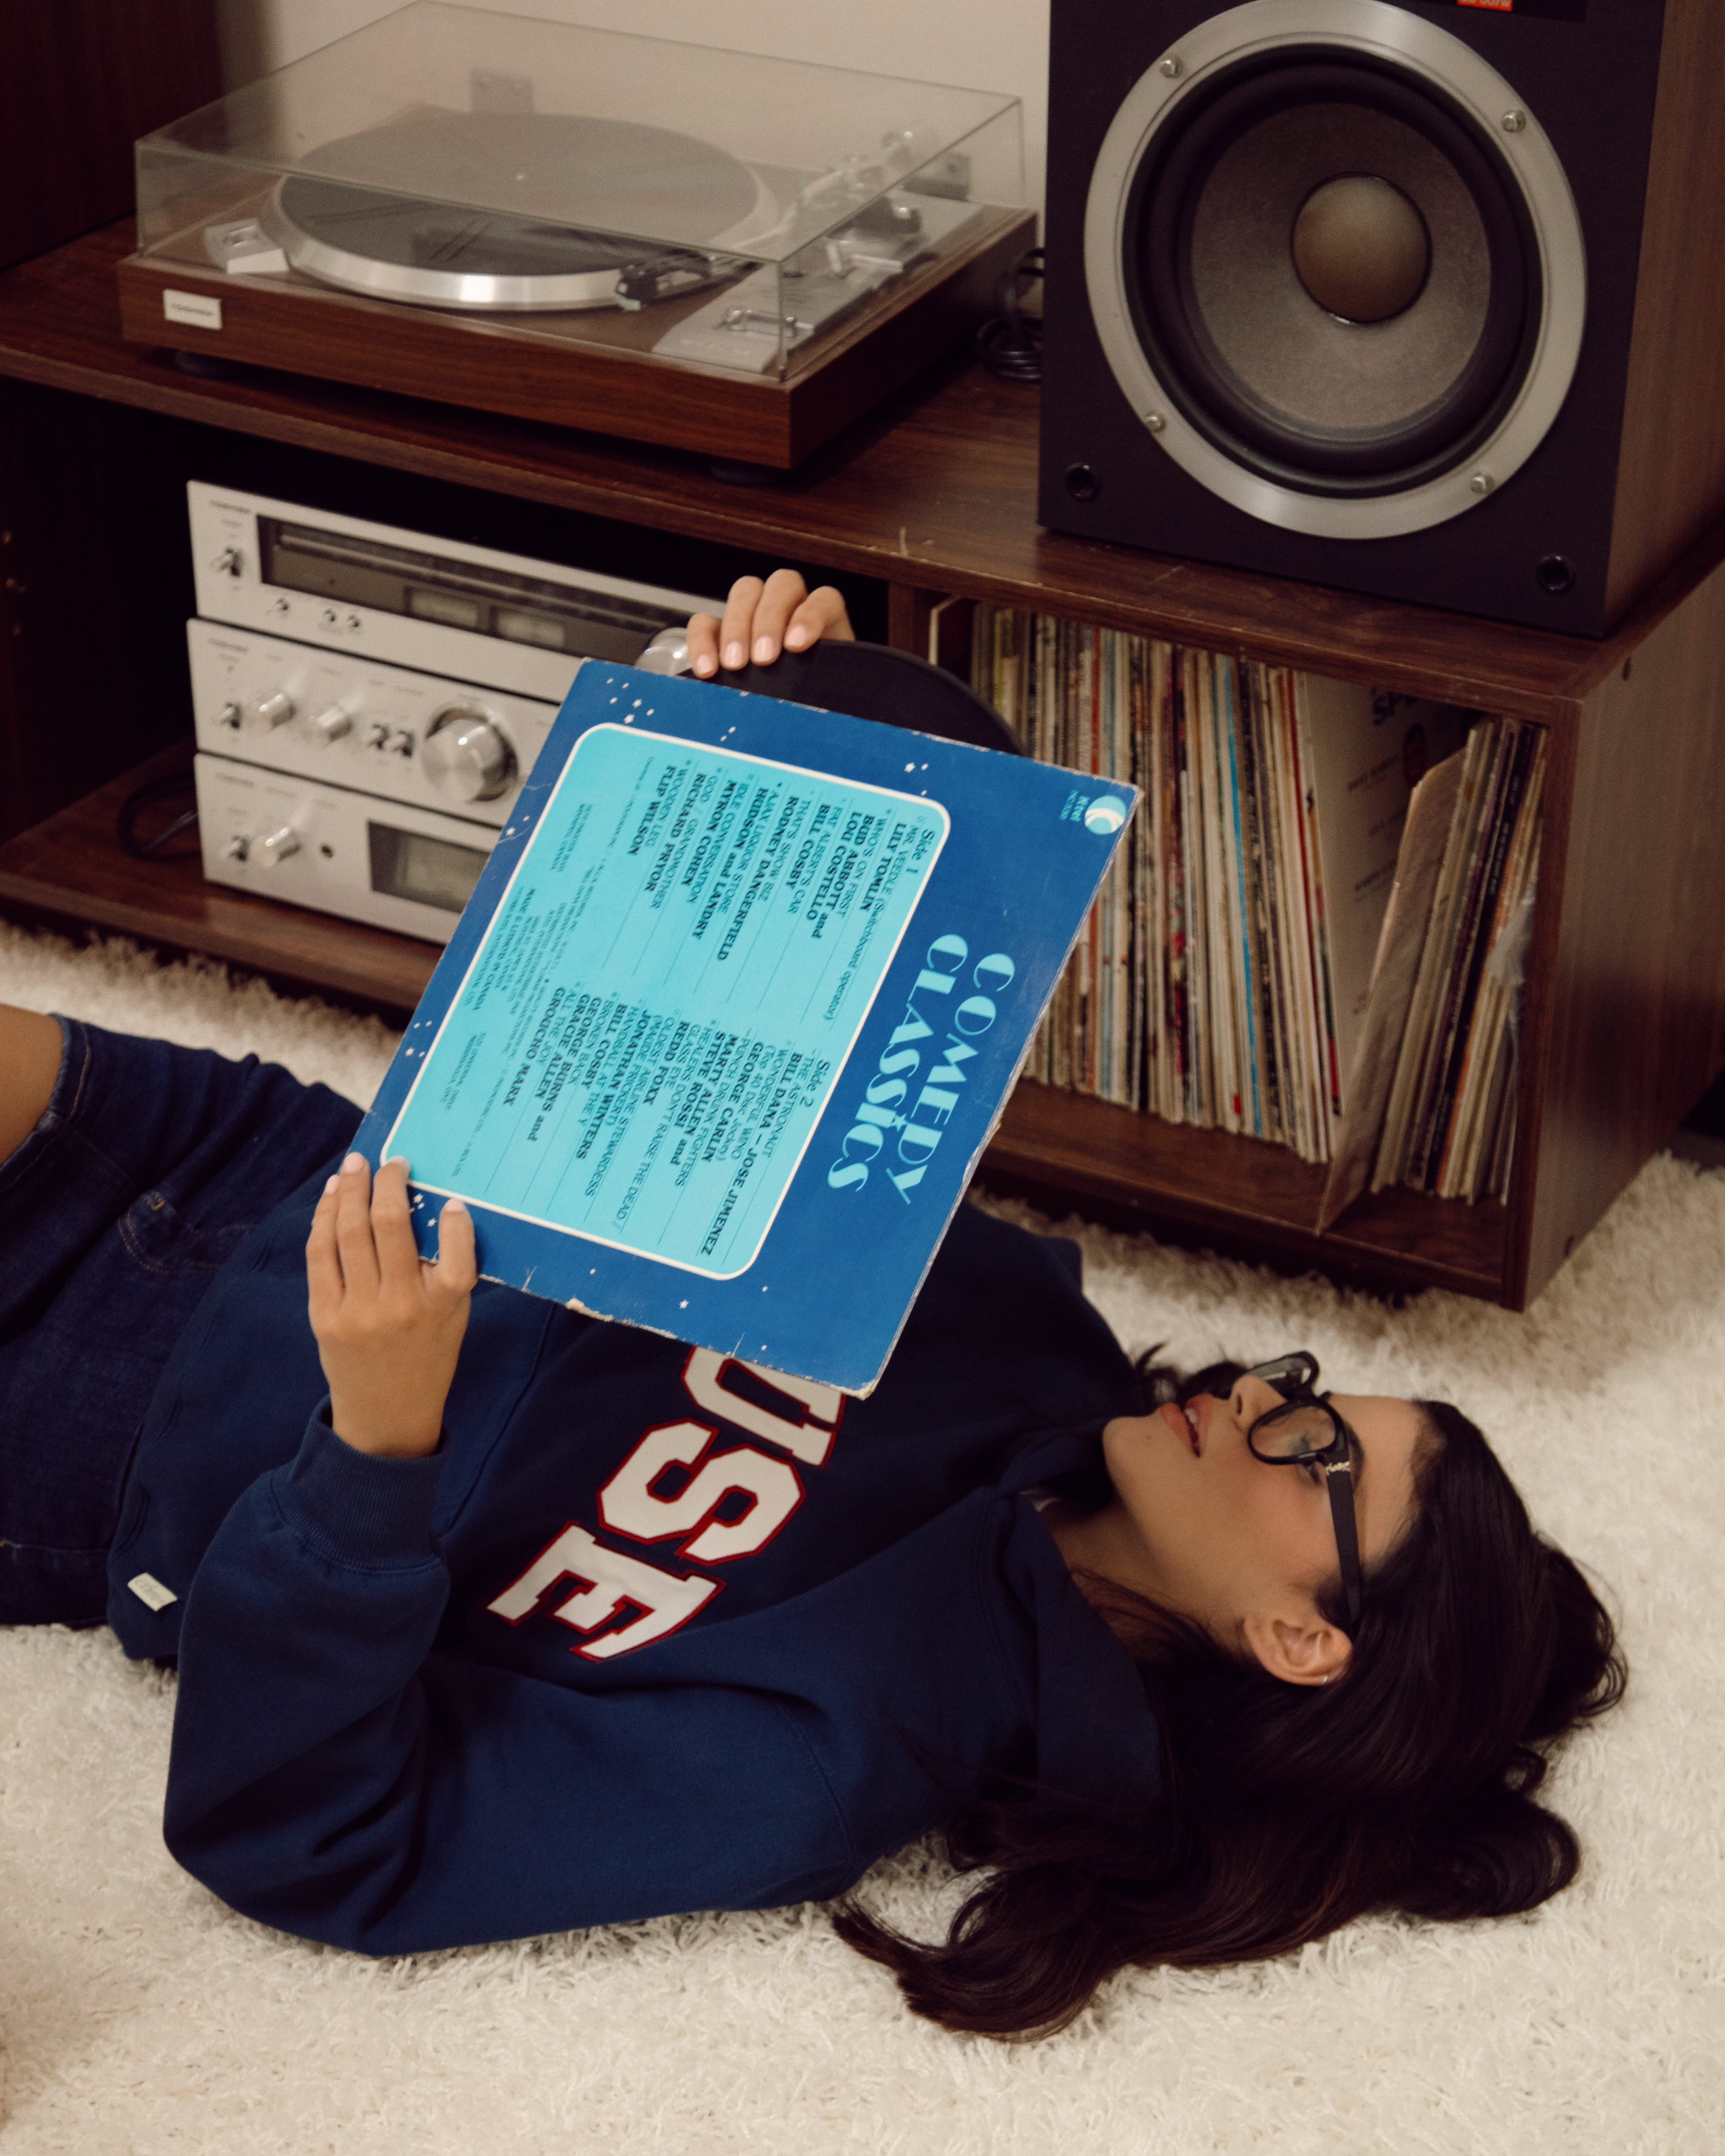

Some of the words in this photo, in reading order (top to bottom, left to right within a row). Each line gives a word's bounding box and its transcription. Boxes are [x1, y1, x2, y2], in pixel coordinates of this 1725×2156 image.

[656, 765, 676, 797] FLIP
[658, 768, 688, 820] WOODEN
[700, 775, 717, 802] GOD
[730, 782, 749, 809] IDLE
[670, 773, 706, 838] RICHARD
[706, 779, 737, 831] MYRON
[733, 787, 768, 849] HUDSON
[758, 792, 779, 821] AJAX
[808, 804, 830, 834] BILL
[826, 806, 843, 828] FAT
[627, 801, 661, 855] WILSON
[644, 824, 662, 847] LEG
[765, 796, 799, 856] RODNEY
[840, 812, 862, 841] LOU
[854, 814, 875, 845] BUD
[886, 822, 907, 853] LILY
[911, 828, 934, 860] Side
[644, 843, 675, 891] PRYOR
[680, 835, 711, 886] COHEN
[687, 812, 735, 903] CONVERSATION
[719, 851, 736, 878] and
[736, 824, 765, 870] LIQUOR
[768, 842, 791, 877] SHOW
[785, 839, 814, 889] COSBY
[806, 845, 847, 920] COSTELLO
[825, 849, 858, 910] ABBOTT
[854, 860, 866, 879] ON
[859, 857, 892, 910] TOMLIN
[691, 881, 726, 939] LANDRY
[716, 872, 742, 914] STORE
[717, 859, 771, 960] DANGERFIELD
[757, 881, 774, 901] BIZ
[787, 889, 805, 914] CAR
[836, 882, 858, 918] FIRST
[810, 912, 828, 939] and
[847, 897, 885, 968] (Switchboard
[472, 973, 494, 1011] CANADA
[561, 991, 577, 1009] ALL
[824, 970, 851, 1020] operator)
[525, 986, 566, 1059] GROUCHO
[548, 1016, 566, 1039] THE
[558, 993, 590, 1049] GRACIE
[566, 997, 602, 1057] GEORGE
[586, 999, 614, 1049] BROKEN
[602, 1006, 639, 1068] HANDBALL
[604, 1003, 627, 1034] BILL
[635, 1014, 662, 1061] (MAUDE
[536, 1040, 552, 1063] JOY
[608, 1009, 651, 1090] JONATHAN
[647, 1016, 674, 1065] OLDEST
[664, 1021, 690, 1061] REDD
[676, 1024, 700, 1064] GLASS
[680, 1027, 713, 1082] HEALERS
[697, 1031, 726, 1078] STEVE
[707, 1034, 738, 1085] MARTY
[724, 1038, 751, 1079] PUNCH
[758, 1045, 776, 1069] (Top
[534, 1051, 562, 1099] ALLEN
[567, 1052, 590, 1084] BACK
[581, 1039, 610, 1090] COSBY
[595, 1074, 608, 1088] AT
[664, 1066, 682, 1089] EYE
[728, 1041, 764, 1103] GEORGE
[750, 1072, 763, 1088] 40
[779, 1052, 803, 1084] BILL
[795, 1057, 814, 1080] THE
[806, 1059, 830, 1091] Side
[827, 933, 968, 1192] CLASSICS
[886, 953, 1015, 1205] COMEDY
[502, 1063, 531, 1106] MARX
[542, 1061, 573, 1111] BURNS
[582, 1092, 600, 1115] THE
[623, 1068, 651, 1114] AIRLINE
[642, 1065, 670, 1105] FOXX
[674, 1081, 703, 1128] ROSSI
[703, 1082, 730, 1123] DRUNK
[737, 1091, 756, 1115] Disc
[746, 1049, 789, 1122] WONDERFUL
[799, 1095, 814, 1107] 2
[576, 1093, 615, 1159] WINTERS
[577, 1118, 588, 1126] Y
[683, 1088, 712, 1136] ALLEN
[758, 1087, 786, 1128] DANA
[762, 1084, 801, 1158] ASTRONAUT
[527, 1115, 544, 1142] and
[644, 1123, 668, 1159] RAISE
[701, 1107, 733, 1162] CARLIN
[716, 1117, 742, 1161] Jockey)
[731, 1127, 753, 1159] WINO
[585, 1116, 629, 1196] STEWARDESS
[669, 1138, 687, 1165] and
[674, 1126, 709, 1186] FIGHTERS
[732, 1147, 757, 1188] JOSE
[631, 1162, 650, 1185] THE
[616, 1186, 639, 1220] DEAD
[700, 1188, 737, 1255] JIMENEZ
